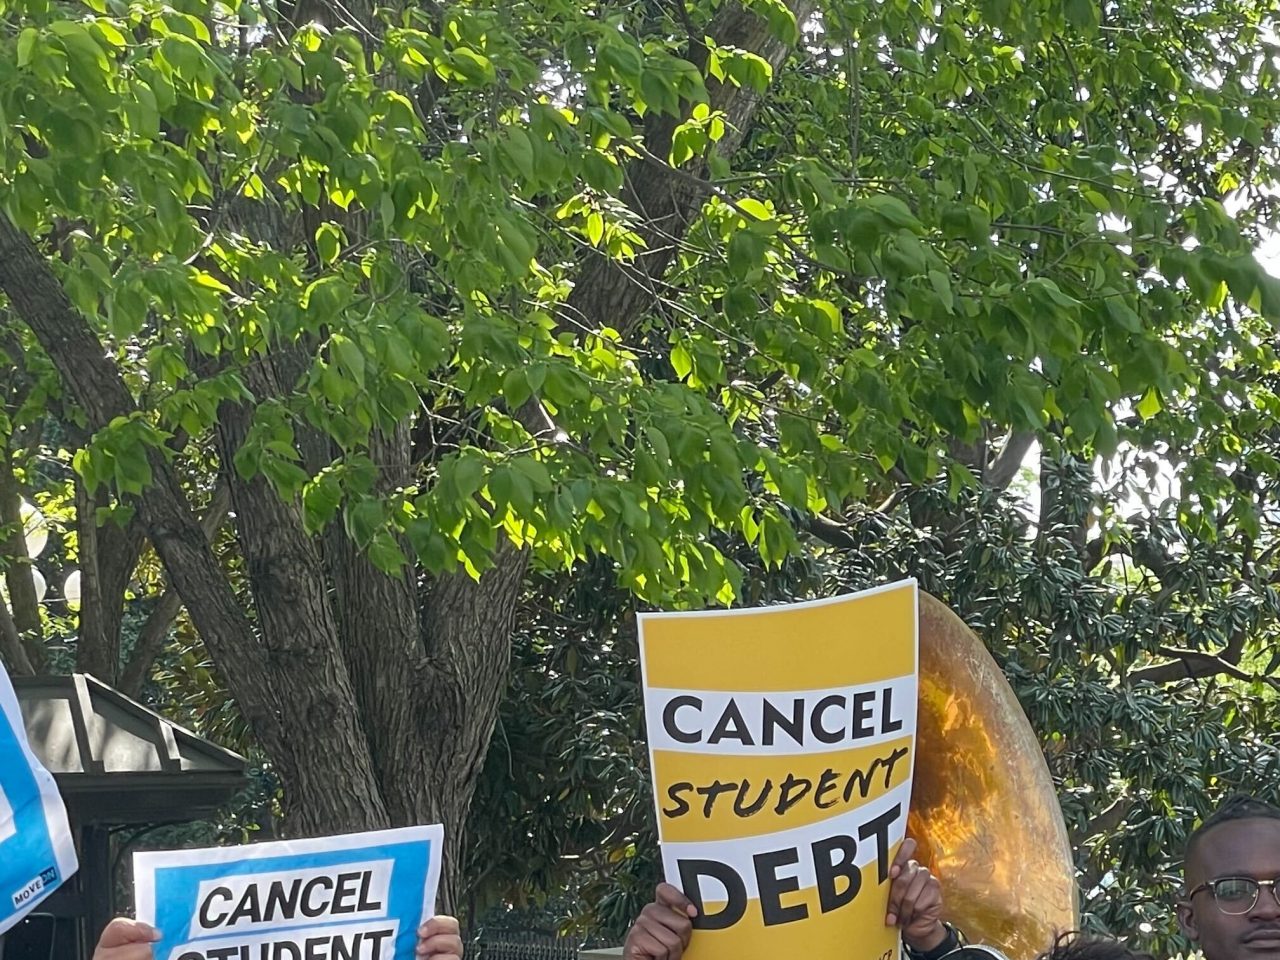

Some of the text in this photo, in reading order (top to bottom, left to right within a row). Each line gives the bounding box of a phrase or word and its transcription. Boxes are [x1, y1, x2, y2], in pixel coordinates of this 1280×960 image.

[662, 687, 904, 747] CANCEL
[663, 746, 909, 819] STUDENT
[198, 869, 382, 929] CANCEL
[677, 801, 903, 931] DEBT
